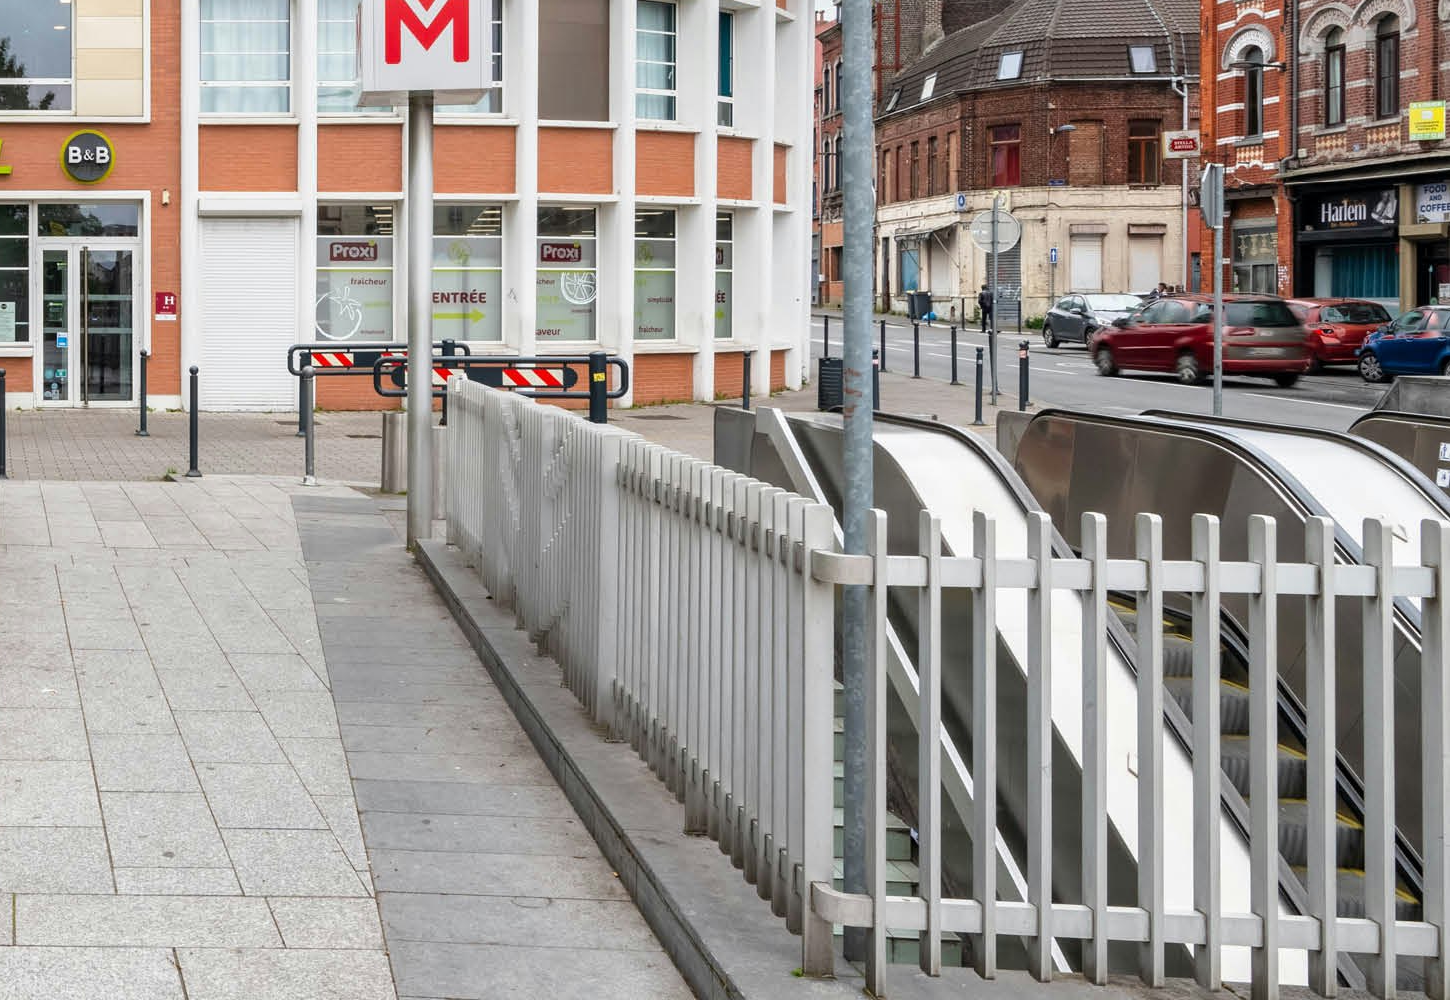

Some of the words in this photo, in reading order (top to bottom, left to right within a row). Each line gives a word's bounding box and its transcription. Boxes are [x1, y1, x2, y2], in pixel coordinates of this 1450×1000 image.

[68, 146, 110, 164] B&B
[1423, 184, 1447, 194] FOOD
[1321, 201, 1367, 223] Harlem
[332, 241, 375, 258] Proxi
[542, 242, 579, 259] Proxi
[164, 295, 175, 306] H
[432, 289, 487, 304] ENTRÉE
